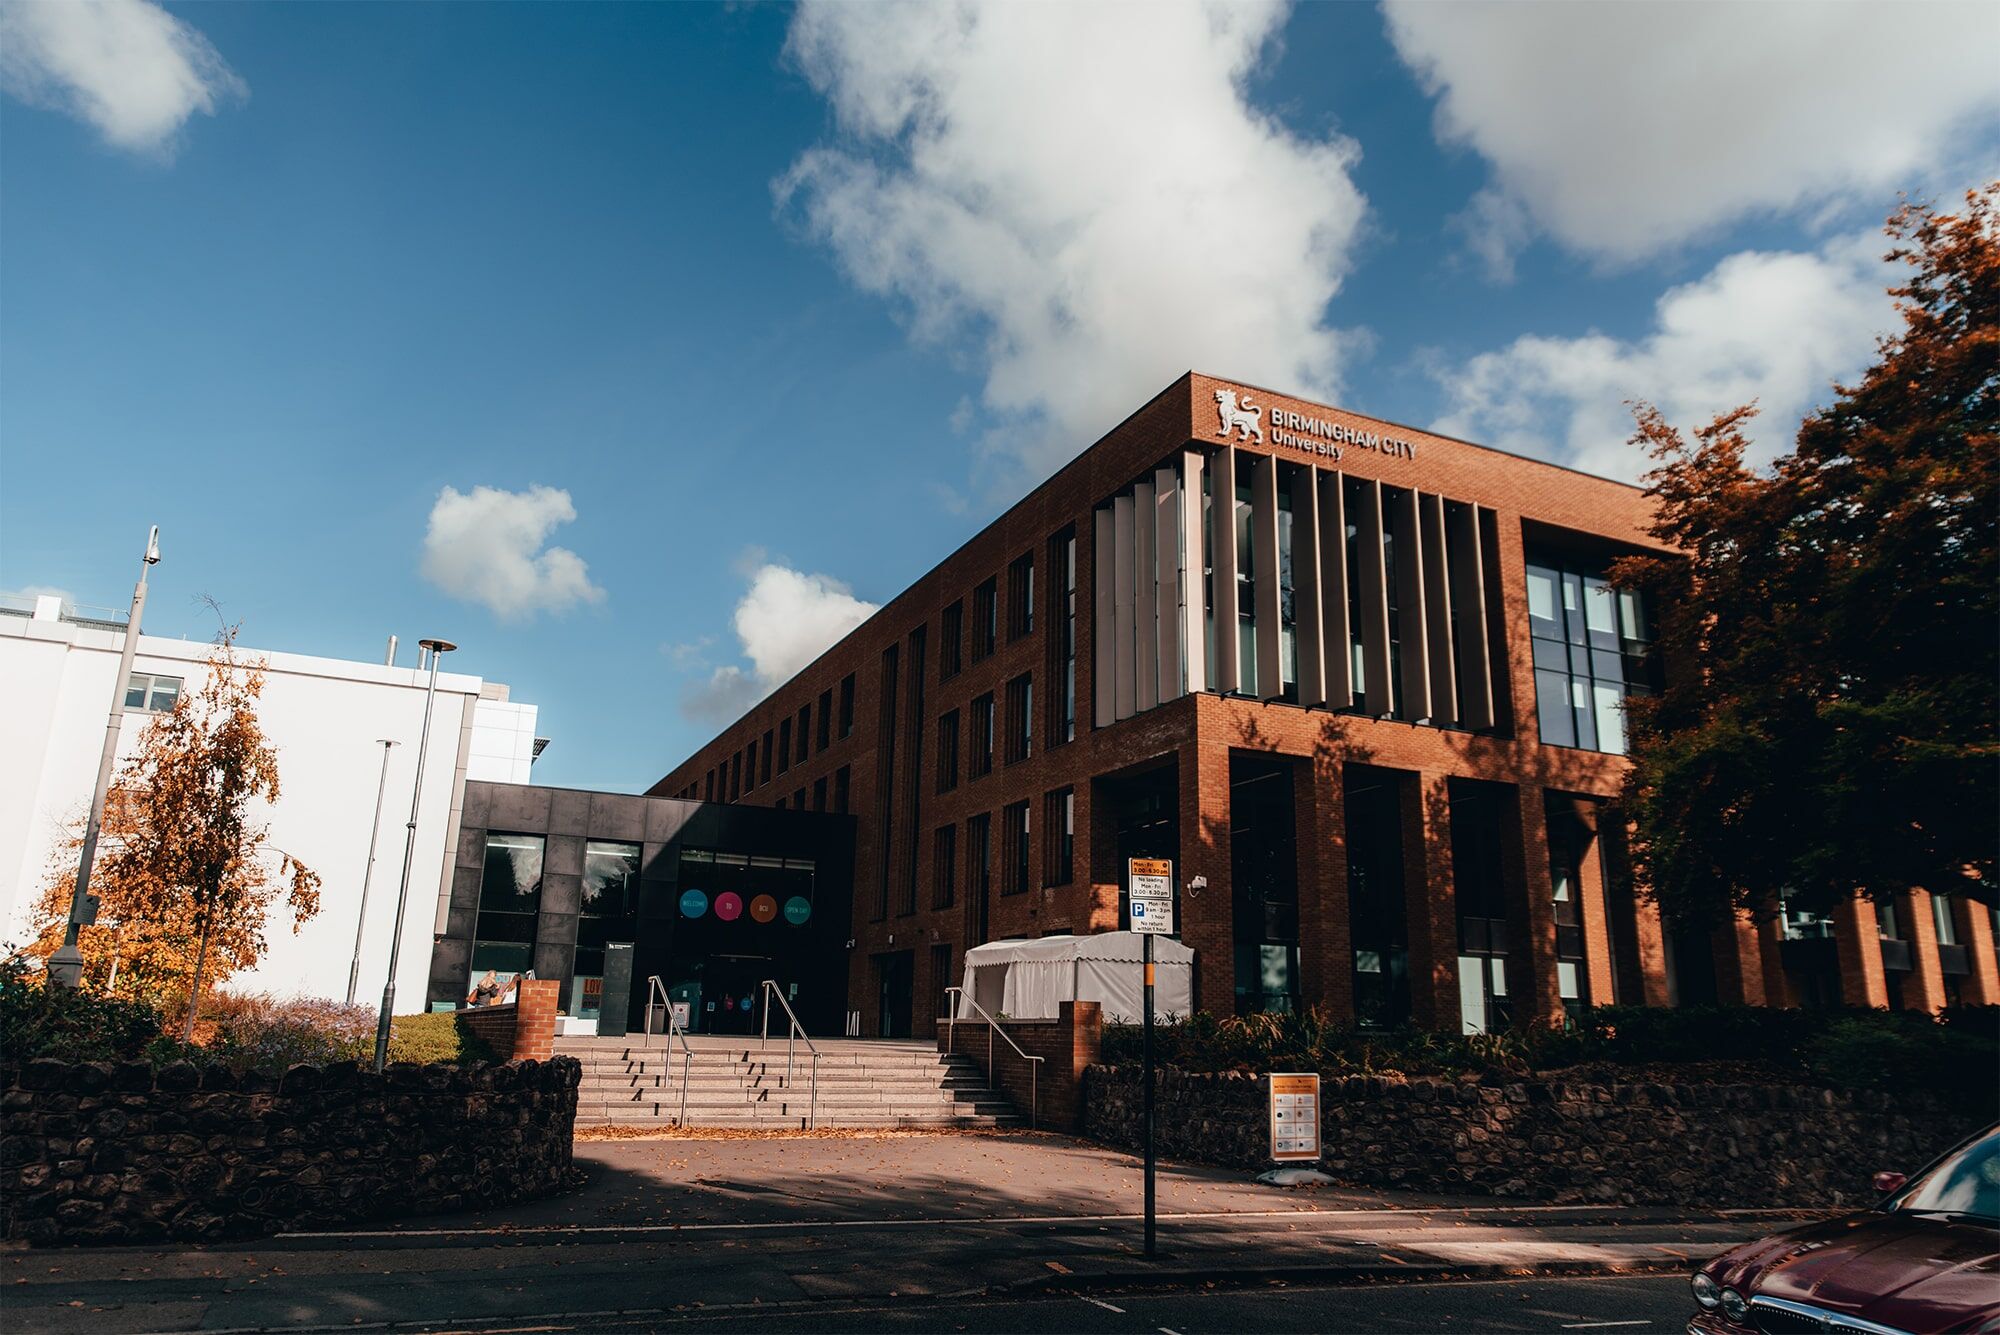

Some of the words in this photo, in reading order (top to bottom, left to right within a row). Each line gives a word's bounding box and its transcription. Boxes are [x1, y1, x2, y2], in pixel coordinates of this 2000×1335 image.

[1271, 408, 1379, 450] BIRMINGHAM
[1382, 436, 1417, 460] CITY
[1272, 428, 1344, 460] University
[1134, 904, 1143, 916] P
[584, 979, 602, 993] LOV
